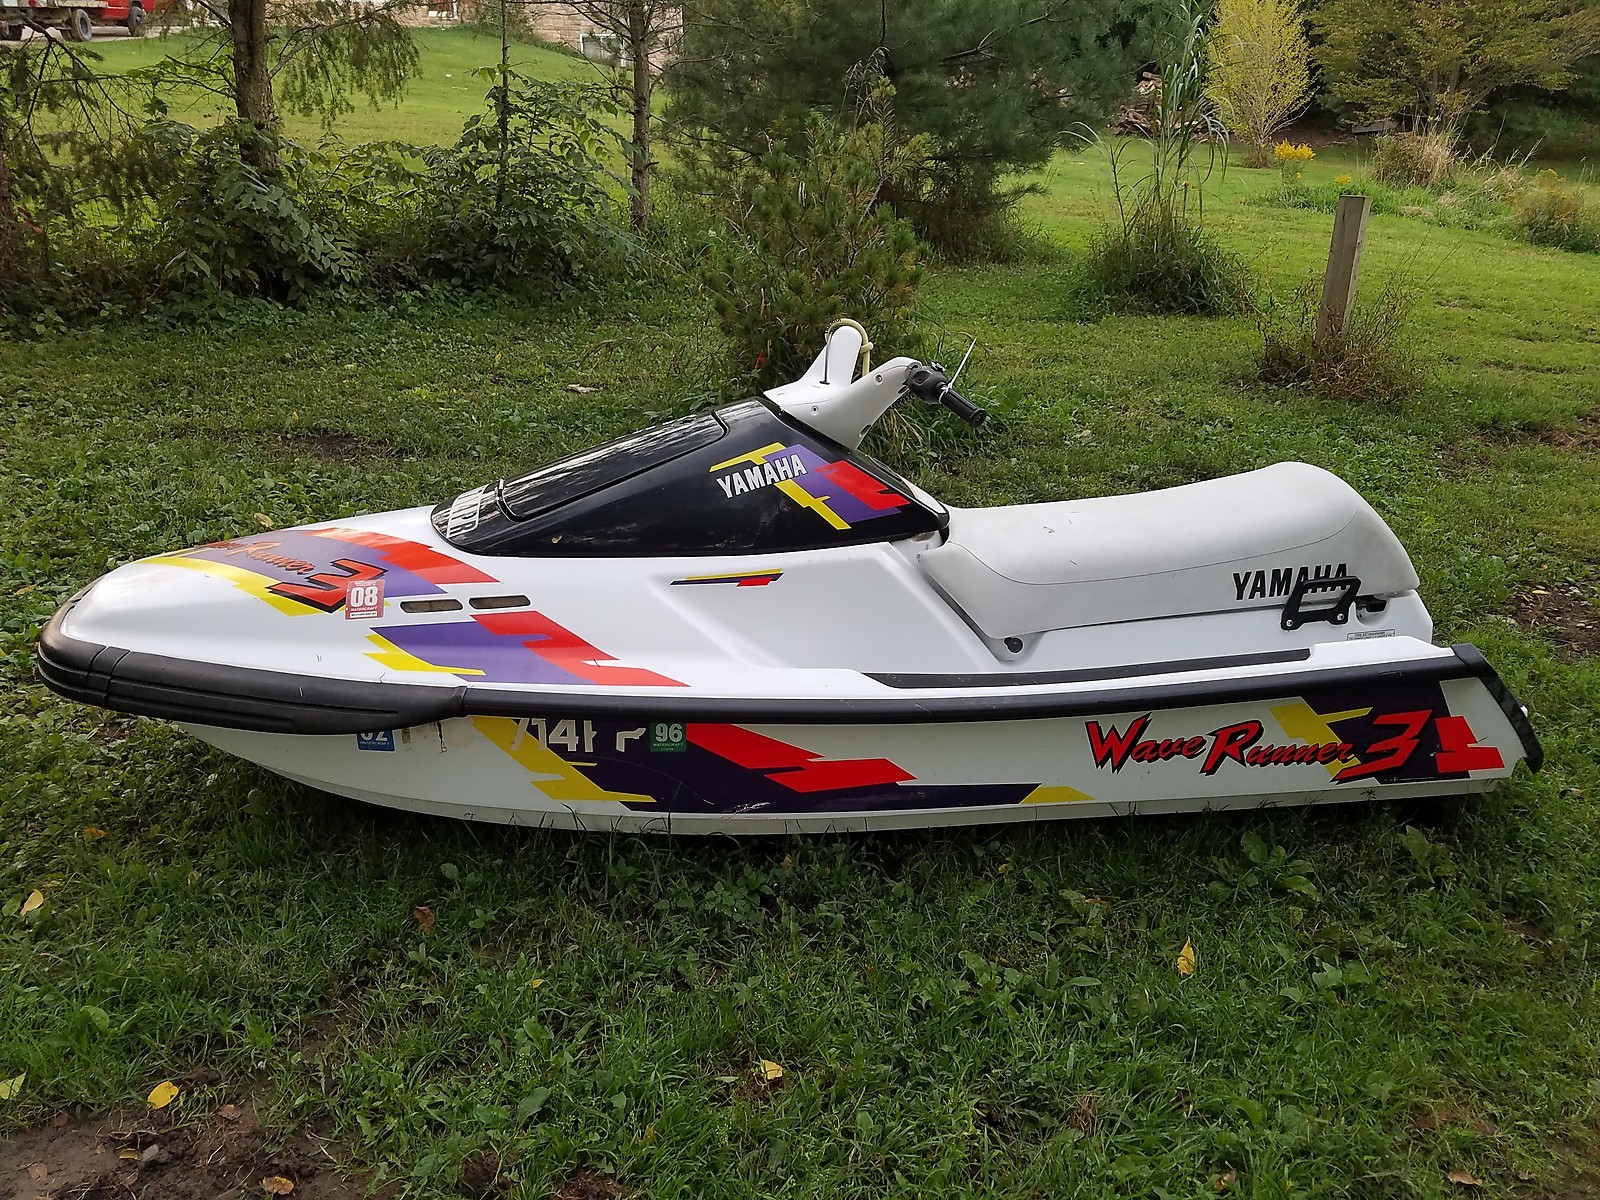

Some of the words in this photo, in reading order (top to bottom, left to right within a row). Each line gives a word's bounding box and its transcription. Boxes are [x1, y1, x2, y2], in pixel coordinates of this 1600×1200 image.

[716, 453, 808, 499] YAMAHA
[350, 586, 378, 608] 08
[1232, 563, 1348, 600] YAMAHA
[655, 722, 683, 743] 96
[1084, 711, 1206, 774] Wave
[1198, 719, 1358, 776] Runner
[1329, 709, 1437, 784] 3
